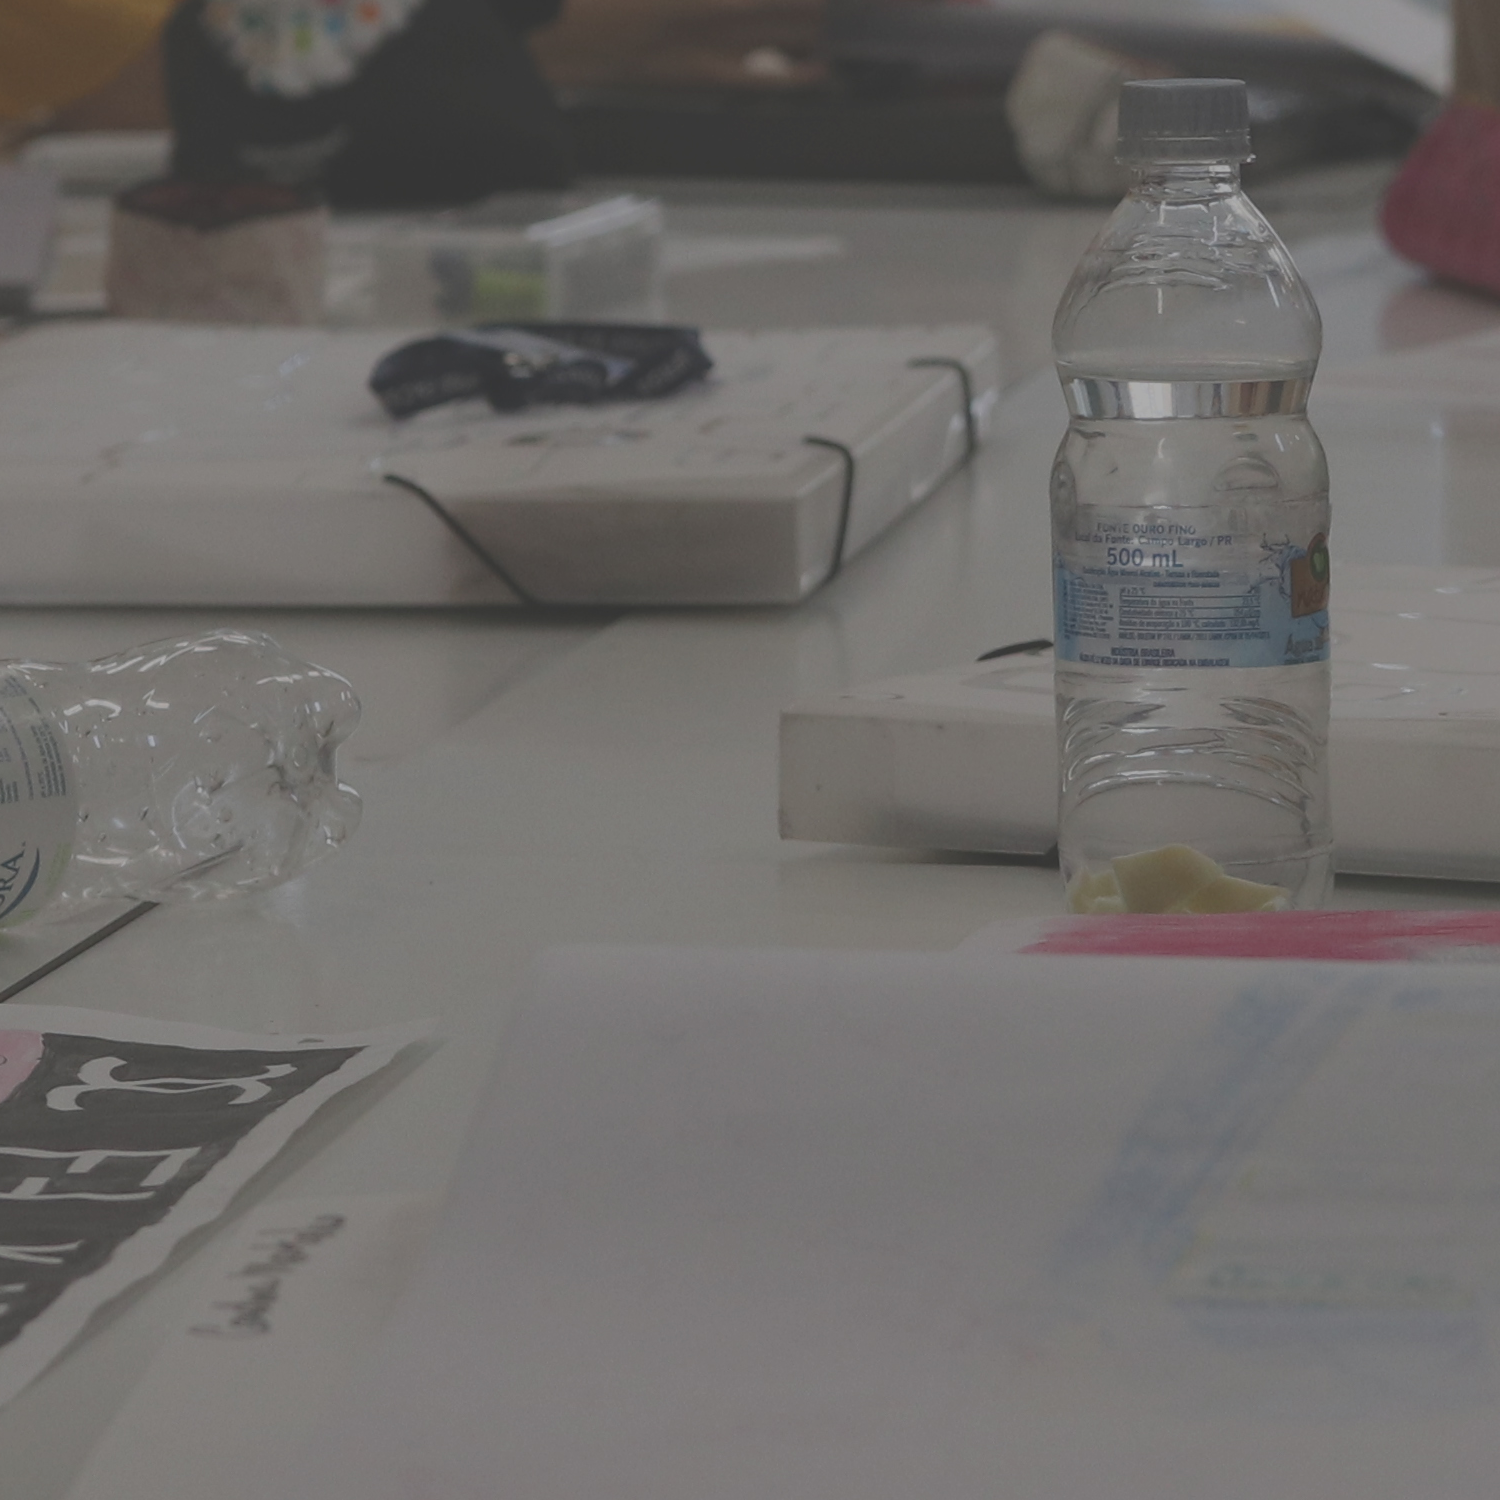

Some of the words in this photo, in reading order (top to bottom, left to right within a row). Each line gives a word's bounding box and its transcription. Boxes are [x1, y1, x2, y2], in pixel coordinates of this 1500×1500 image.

[1096, 522, 1130, 533] FONTE
[1132, 524, 1164, 535] OURO
[1168, 525, 1196, 535] FINO
[1139, 536, 1174, 548] Campo
[1177, 537, 1208, 548] Largo
[1216, 535, 1232, 547] PR
[1107, 547, 1145, 567] 500
[1152, 549, 1184, 568] mL
[1140, 648, 1176, 658] BRASILEIRA
